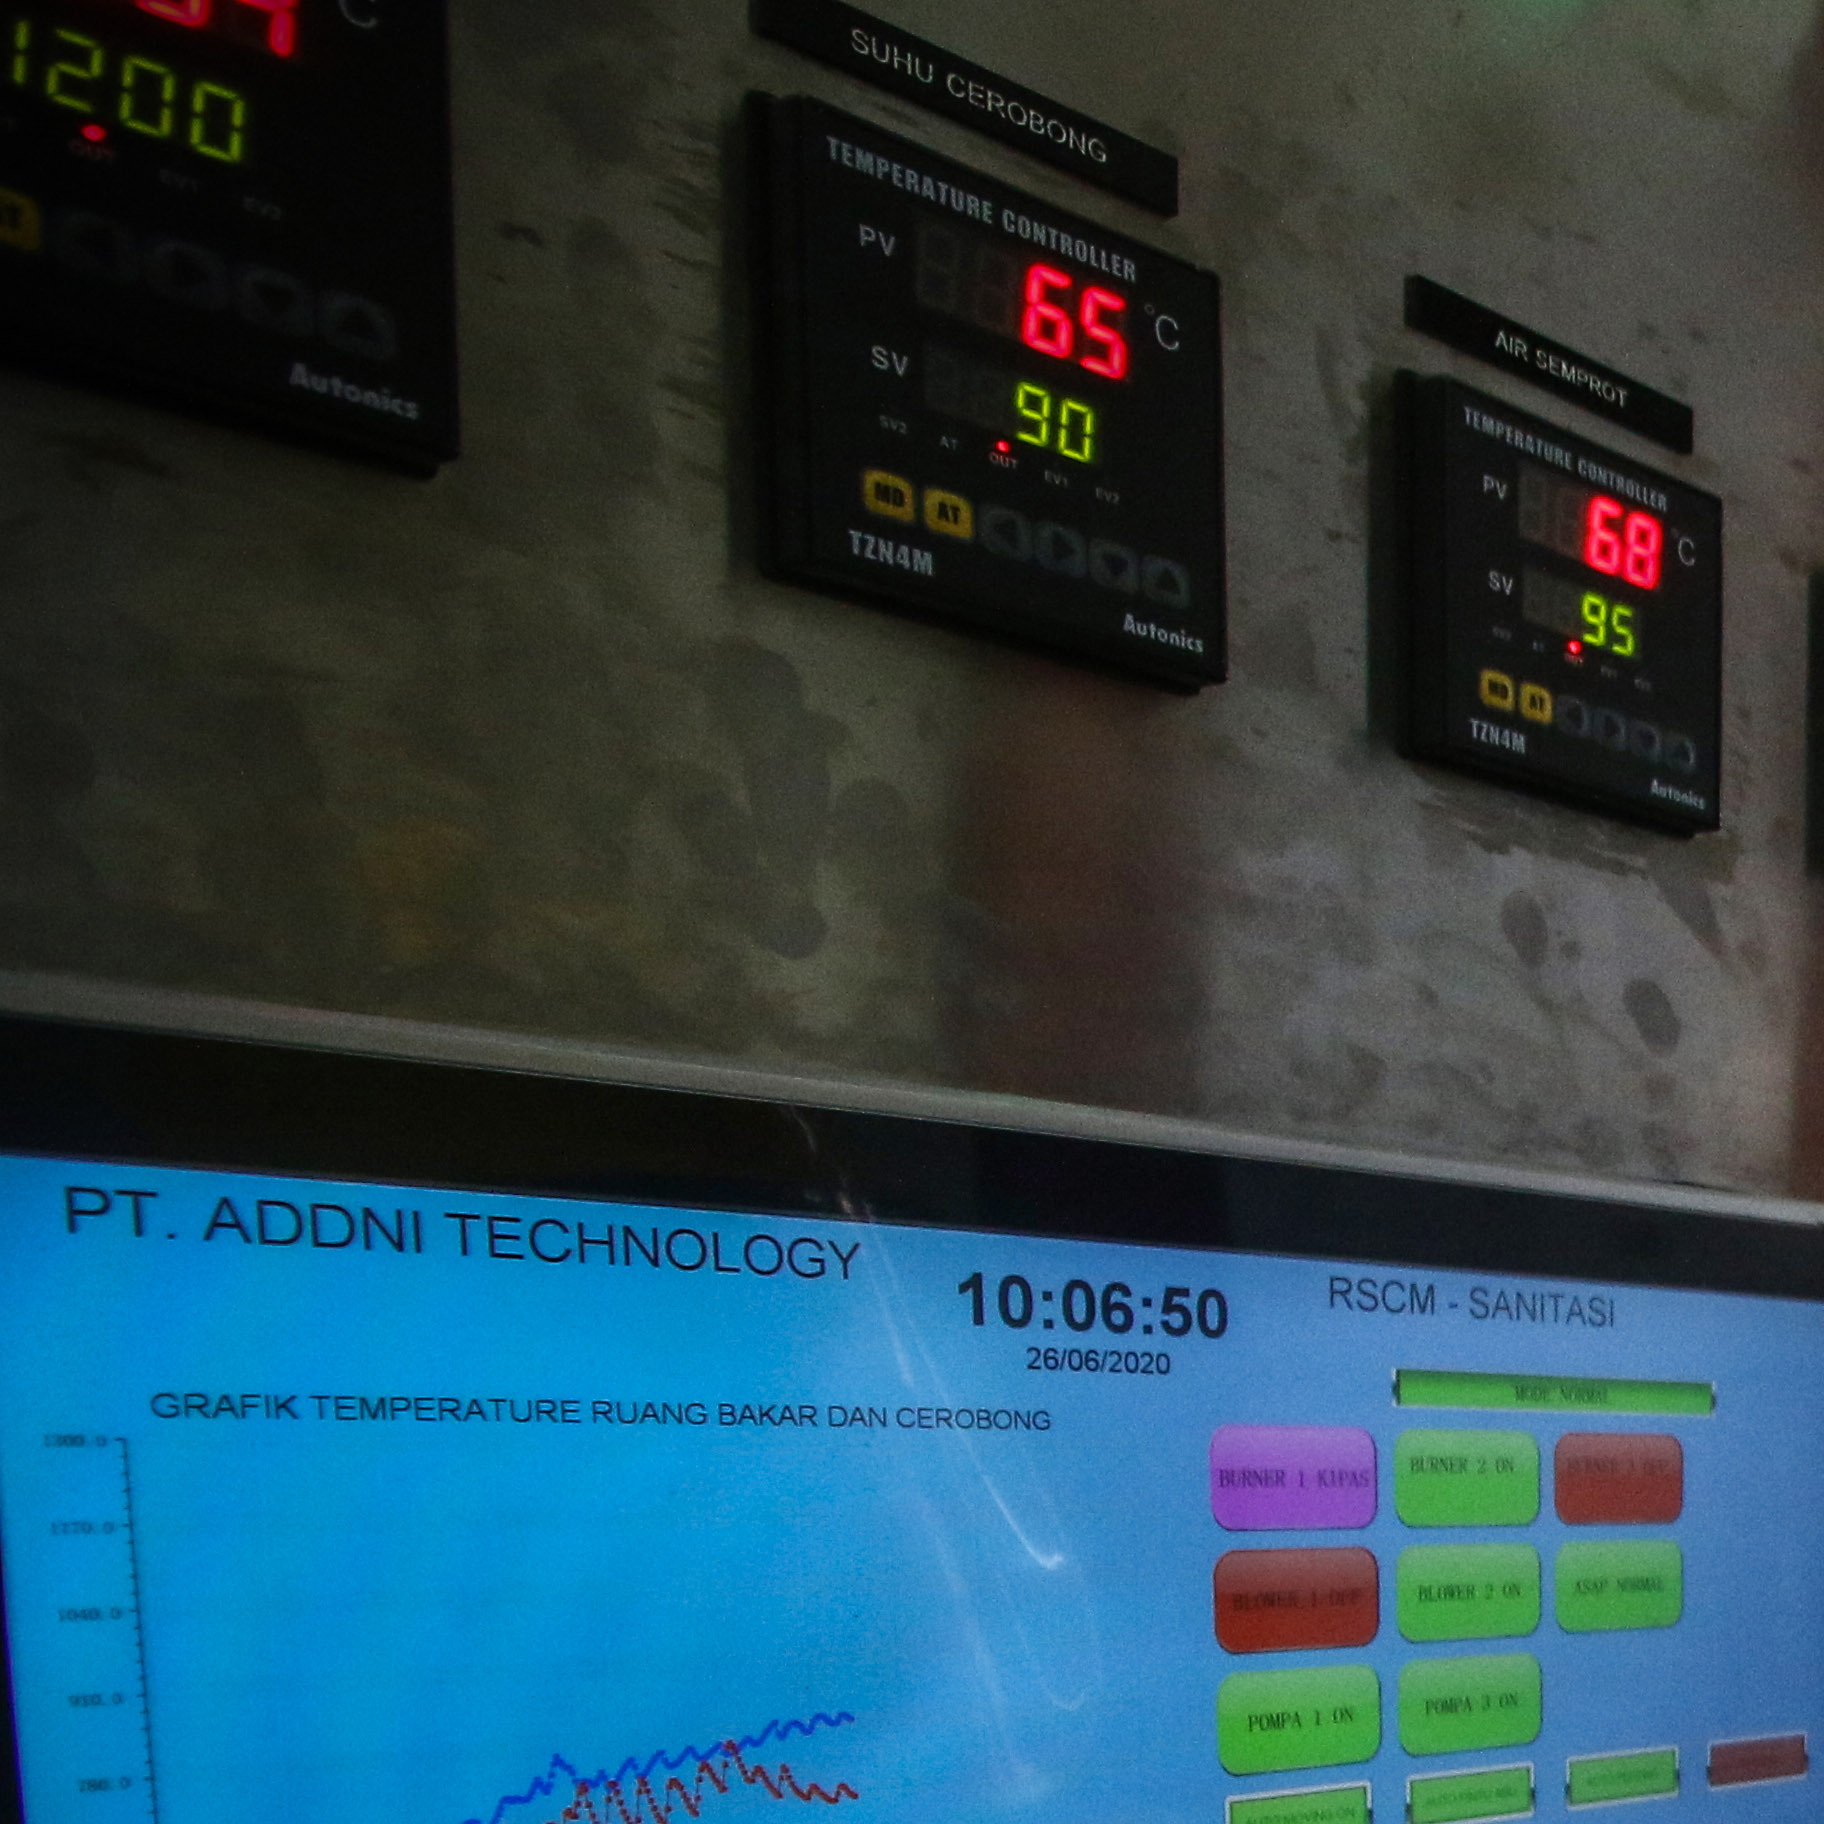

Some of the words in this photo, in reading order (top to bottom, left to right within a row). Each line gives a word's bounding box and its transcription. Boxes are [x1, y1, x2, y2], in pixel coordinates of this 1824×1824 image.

[12, 20, 247, 164] 1200
[850, 28, 934, 85] SUHU
[946, 71, 1109, 164] CEROBONG
[826, 135, 994, 225] TEMPERATURE
[1002, 209, 1137, 283] CONTROLLER
[857, 223, 896, 257] PV
[1021, 261, 1128, 382] 65
[870, 344, 909, 378] SV
[1494, 329, 1528, 363] AIR
[1536, 349, 1630, 408] SEMPROT
[288, 362, 420, 421] Autonics
[1015, 381, 1095, 464] 90
[1463, 405, 1573, 471] TEMPERATURE
[1576, 451, 1668, 512] CONTROLLER
[1482, 474, 1508, 501] PV
[847, 528, 934, 577] TZN4M
[1585, 494, 1665, 592] 68
[1487, 570, 1514, 598] SV
[1123, 612, 1204, 655] Autonics
[1580, 591, 1637, 658] 95
[63, 1185, 176, 1240] PT.
[203, 1196, 423, 1255] ADDNI
[444, 1211, 861, 1281] TECHNOLOGY
[957, 1271, 1229, 1340] 10:06:50
[1328, 1275, 1437, 1316] RSCM
[1468, 1288, 1617, 1329] SANITASI
[1026, 1346, 1172, 1376] 26/06/2020
[150, 1391, 301, 1420] GRAFIK
[310, 1394, 582, 1425] TEMPERATURE
[592, 1400, 708, 1427] RUANG
[717, 1402, 819, 1428] BAKAR
[828, 1405, 888, 1429] DAN
[896, 1405, 1053, 1432] CEROBONG
[1219, 1468, 1286, 1488] BURNER
[1317, 1468, 1371, 1488] KIPAS
[1410, 1457, 1467, 1475] BURNER
[1495, 1457, 1515, 1474] ON
[1417, 1584, 1476, 1602] BLOWER
[1248, 1711, 1302, 1732] POMPA
[1333, 1706, 1355, 1724] ON
[1425, 1697, 1472, 1716] POMPA
[1498, 1692, 1519, 1708] ON
